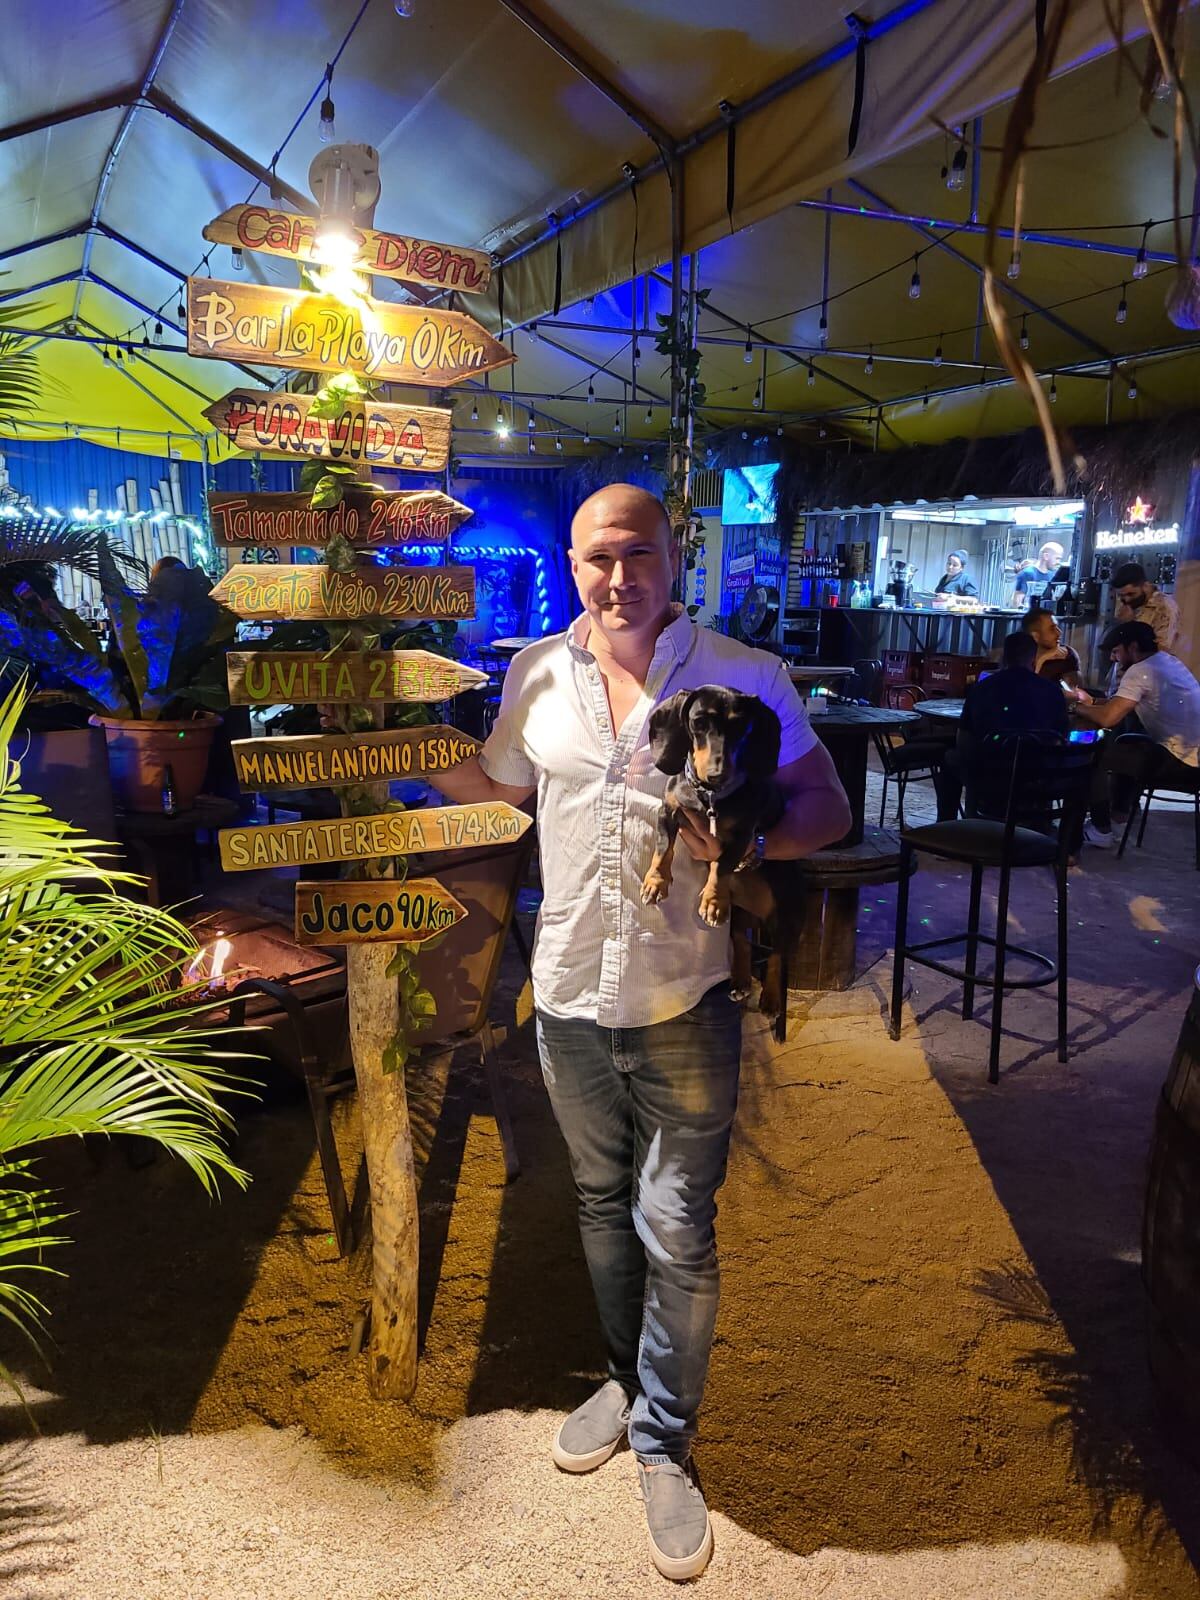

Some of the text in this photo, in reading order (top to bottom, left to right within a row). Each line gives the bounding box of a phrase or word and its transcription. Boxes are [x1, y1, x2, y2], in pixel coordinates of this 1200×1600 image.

[371, 232, 486, 288] Diem
[196, 291, 276, 349] Bar
[318, 309, 406, 374] Playa
[1095, 526, 1178, 549] Heineken
[224, 569, 469, 618] Puerto Viejo 230Km
[418, 738, 476, 771] 158Km
[436, 810, 521, 846] 174Km
[302, 892, 394, 935] Jaco
